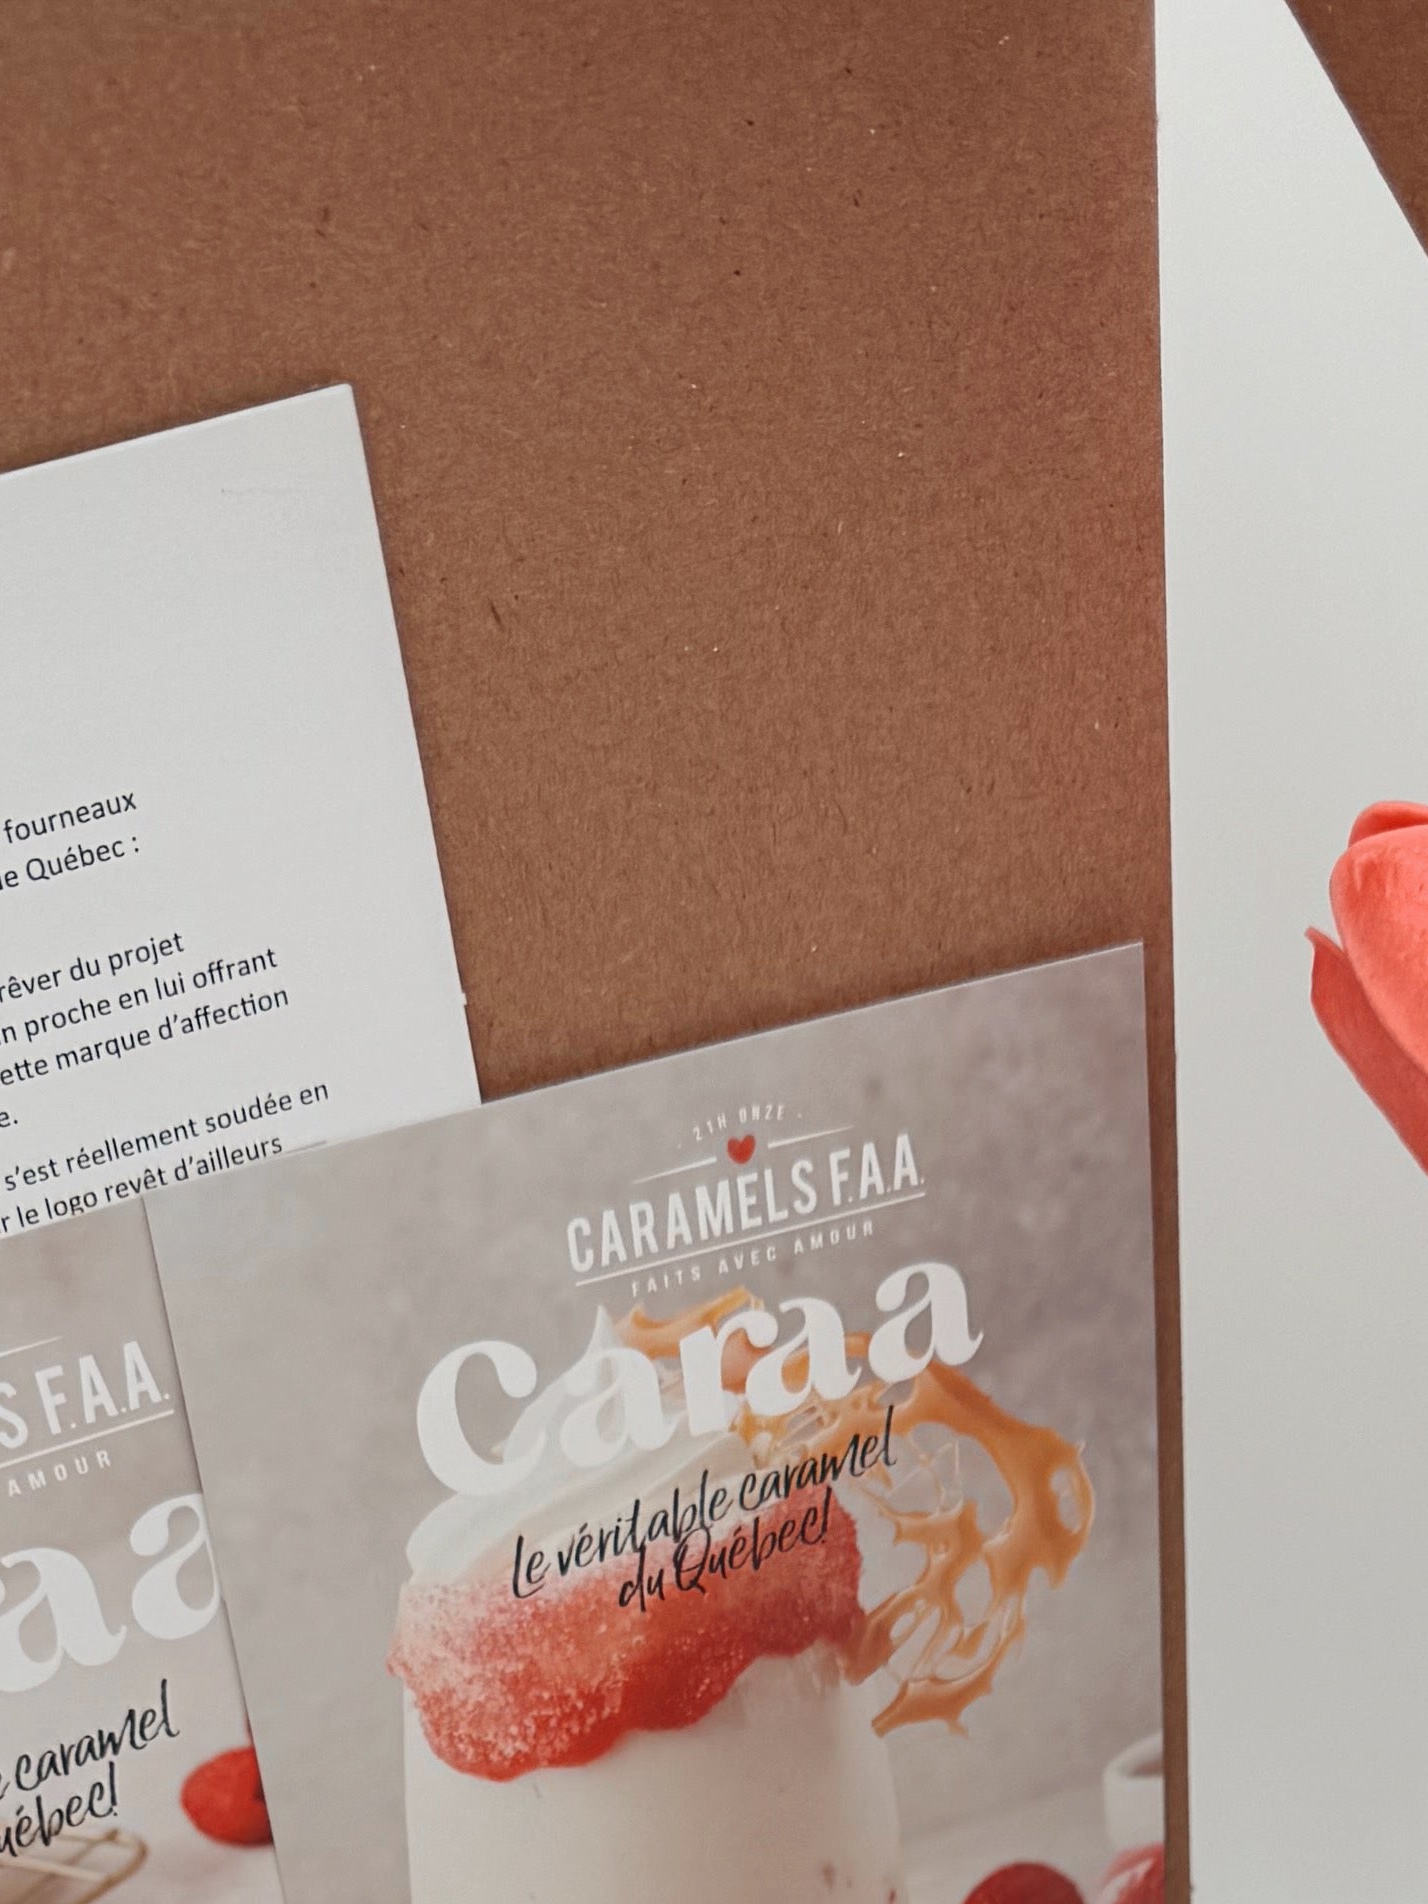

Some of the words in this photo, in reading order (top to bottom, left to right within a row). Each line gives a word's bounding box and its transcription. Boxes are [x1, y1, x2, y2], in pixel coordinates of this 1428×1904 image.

[2, 791, 138, 845] fourneaux
[692, 1113, 729, 1142] 21H
[738, 1102, 787, 1127] ONZE
[565, 1153, 818, 1273] CARAMELS
[631, 1263, 702, 1299] FAITS
[717, 1245, 778, 1277] AVEC
[792, 1221, 876, 1258] AMOUR
[34, 1340, 170, 1436] F.A.A.
[7, 1450, 113, 1496] AMOUR
[556, 1469, 734, 1573] véritable
[738, 1404, 899, 1511] caramel
[617, 1544, 666, 1613] du
[672, 1486, 835, 1595] Québec!
[15, 1679, 180, 1787] caramel
